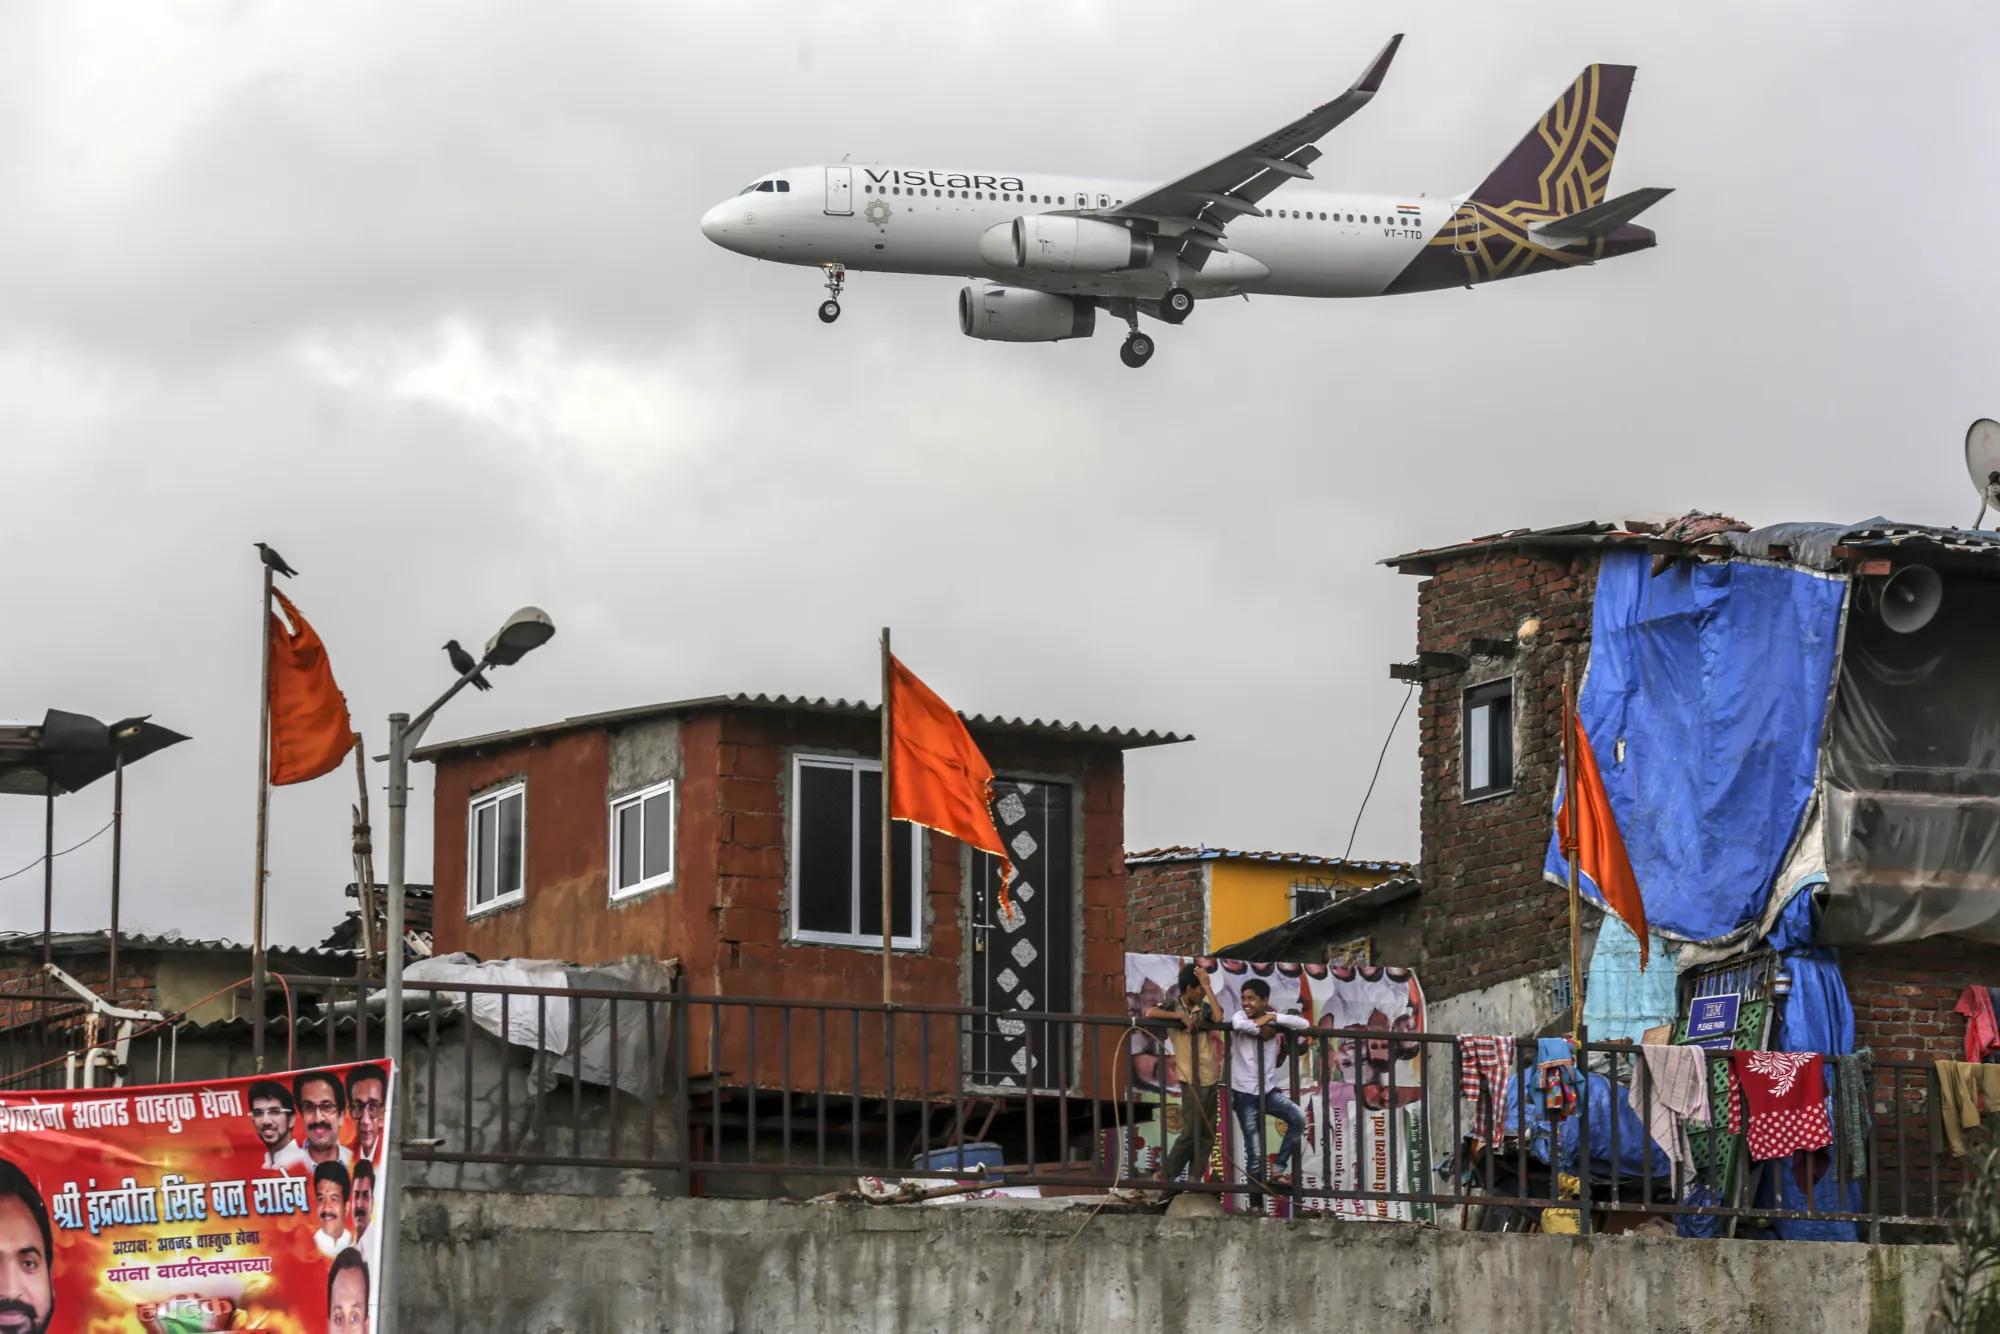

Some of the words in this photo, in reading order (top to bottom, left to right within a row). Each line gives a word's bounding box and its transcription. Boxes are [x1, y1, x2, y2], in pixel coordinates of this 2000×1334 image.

[1384, 229, 1422, 240] VT-TTD
[1697, 1022, 1712, 1031] PLEASE
[72, 1098, 129, 1128] अवजड
[135, 1092, 196, 1133] वाहतुक
[199, 1087, 242, 1118] सेना
[52, 1182, 83, 1229] श्री
[86, 1177, 158, 1234] इंद्रजीत
[161, 1174, 207, 1221] सिंह
[210, 1179, 248, 1216] बल
[252, 1167, 309, 1214] साहेब
[158, 1236, 192, 1251] अवजड
[197, 1232, 232, 1252] वाहतुक
[236, 1229, 260, 1246] सेना
[107, 1262, 150, 1282] यांना
[156, 1256, 272, 1279] वाढदिवसाच्या
